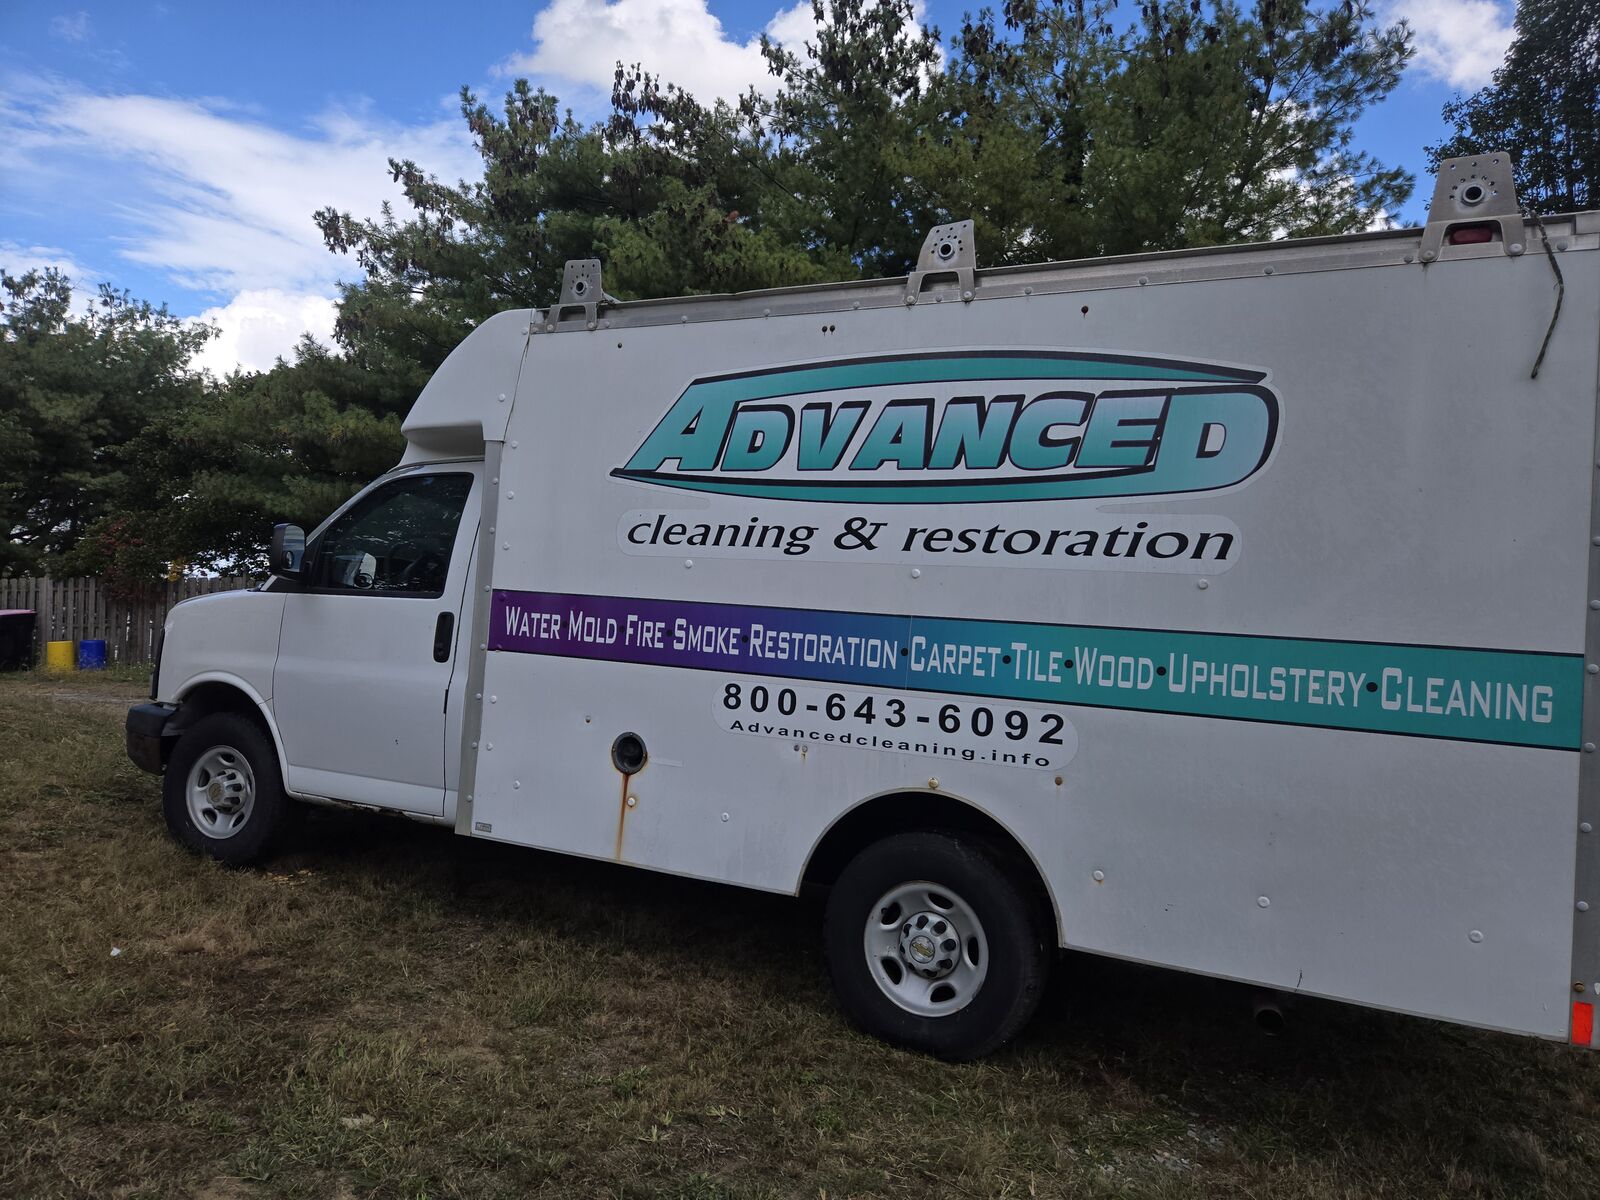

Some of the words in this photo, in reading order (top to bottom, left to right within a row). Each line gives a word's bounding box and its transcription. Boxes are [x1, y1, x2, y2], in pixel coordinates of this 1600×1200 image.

[614, 368, 1280, 498] ADVANCED
[627, 515, 819, 556] cleaning
[833, 516, 888, 552] &
[901, 521, 1235, 561] restoration
[505, 605, 561, 639] WATER
[565, 610, 618, 645] MOLD
[624, 614, 666, 649] FIRE
[672, 618, 741, 656] SMOKE
[748, 623, 899, 670] RESTORATION
[909, 635, 1002, 678] CARPET
[1011, 642, 1064, 684] TILE
[1074, 646, 1155, 691] WOOD
[1168, 652, 1367, 708] UPHOLSTERY
[1381, 667, 1554, 724] CLEANING
[722, 682, 1065, 746] 800-643-6092
[729, 719, 1051, 768] Advancedcleaning.info
